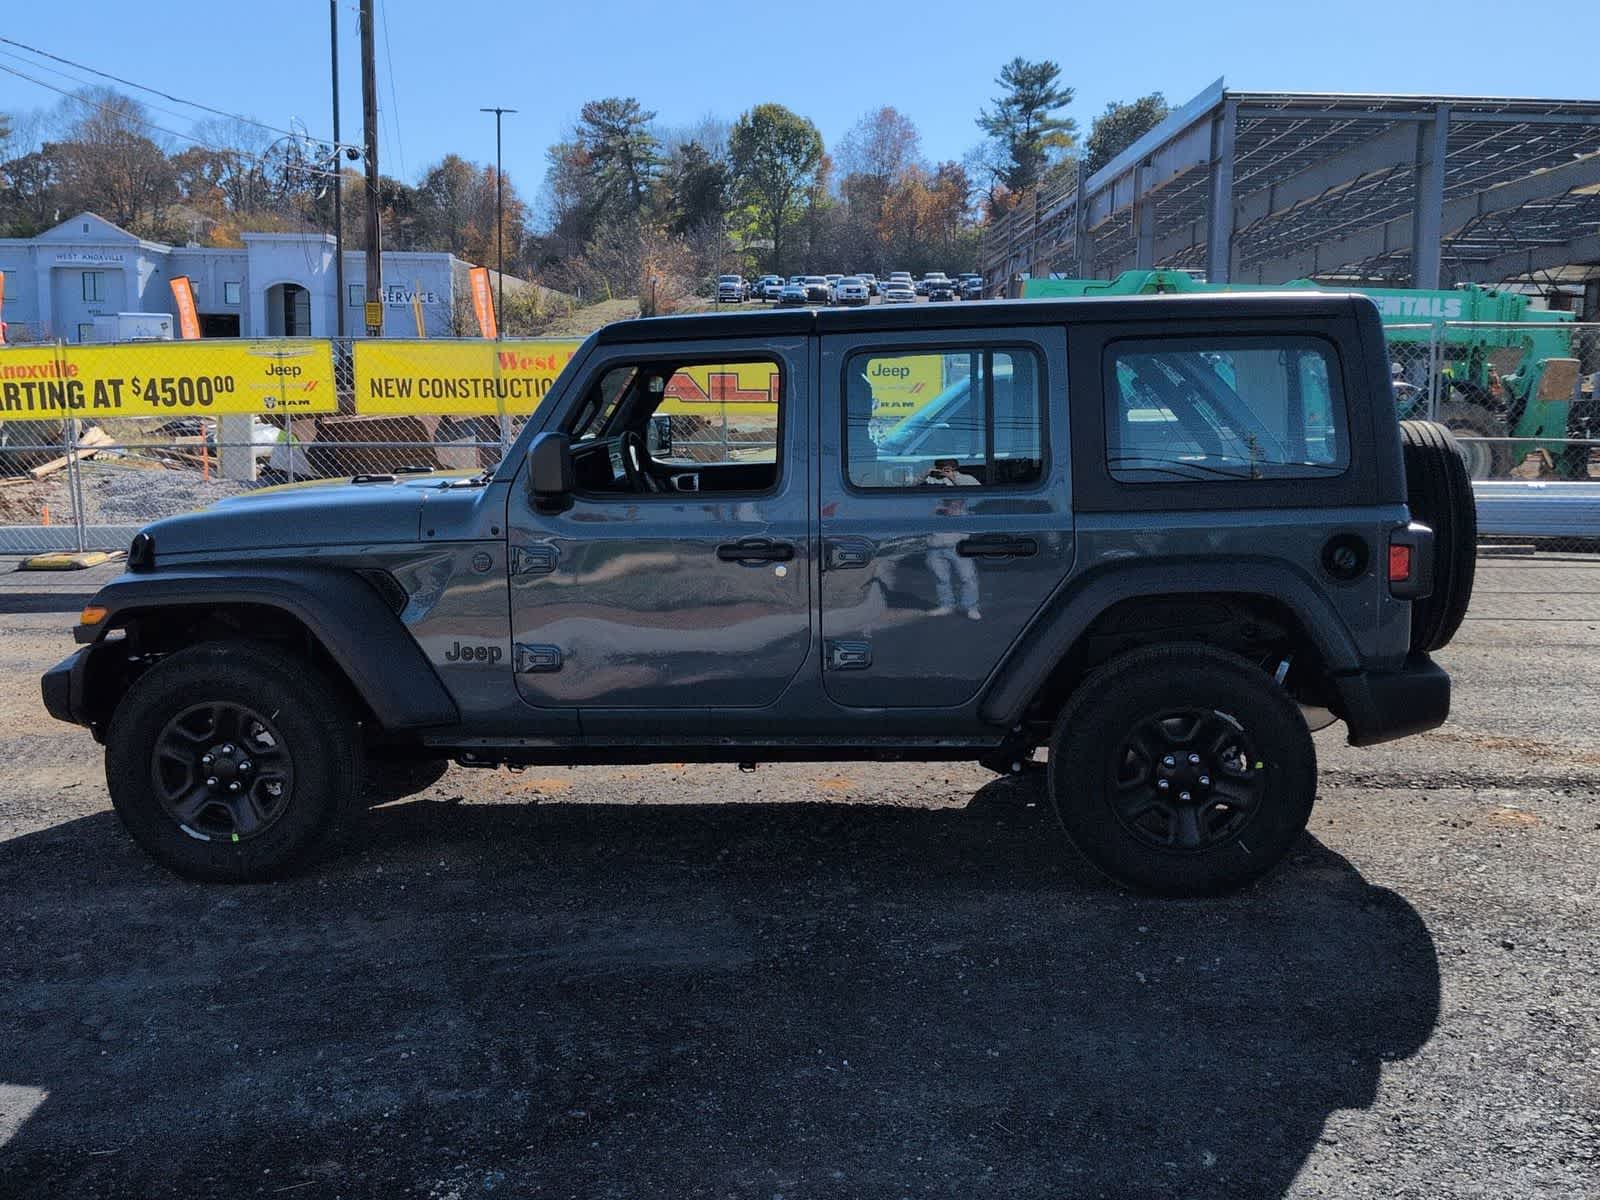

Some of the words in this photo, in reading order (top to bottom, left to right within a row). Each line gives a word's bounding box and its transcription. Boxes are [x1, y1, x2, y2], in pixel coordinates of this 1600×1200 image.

[0, 360, 78, 379] noxville
[265, 363, 302, 378] Jeep
[499, 352, 556, 370] West
[872, 364, 910, 379] Jeep
[0, 380, 86, 411] RTING
[93, 379, 124, 408] AT
[370, 378, 412, 398] NEW
[445, 641, 502, 664] Jeep
